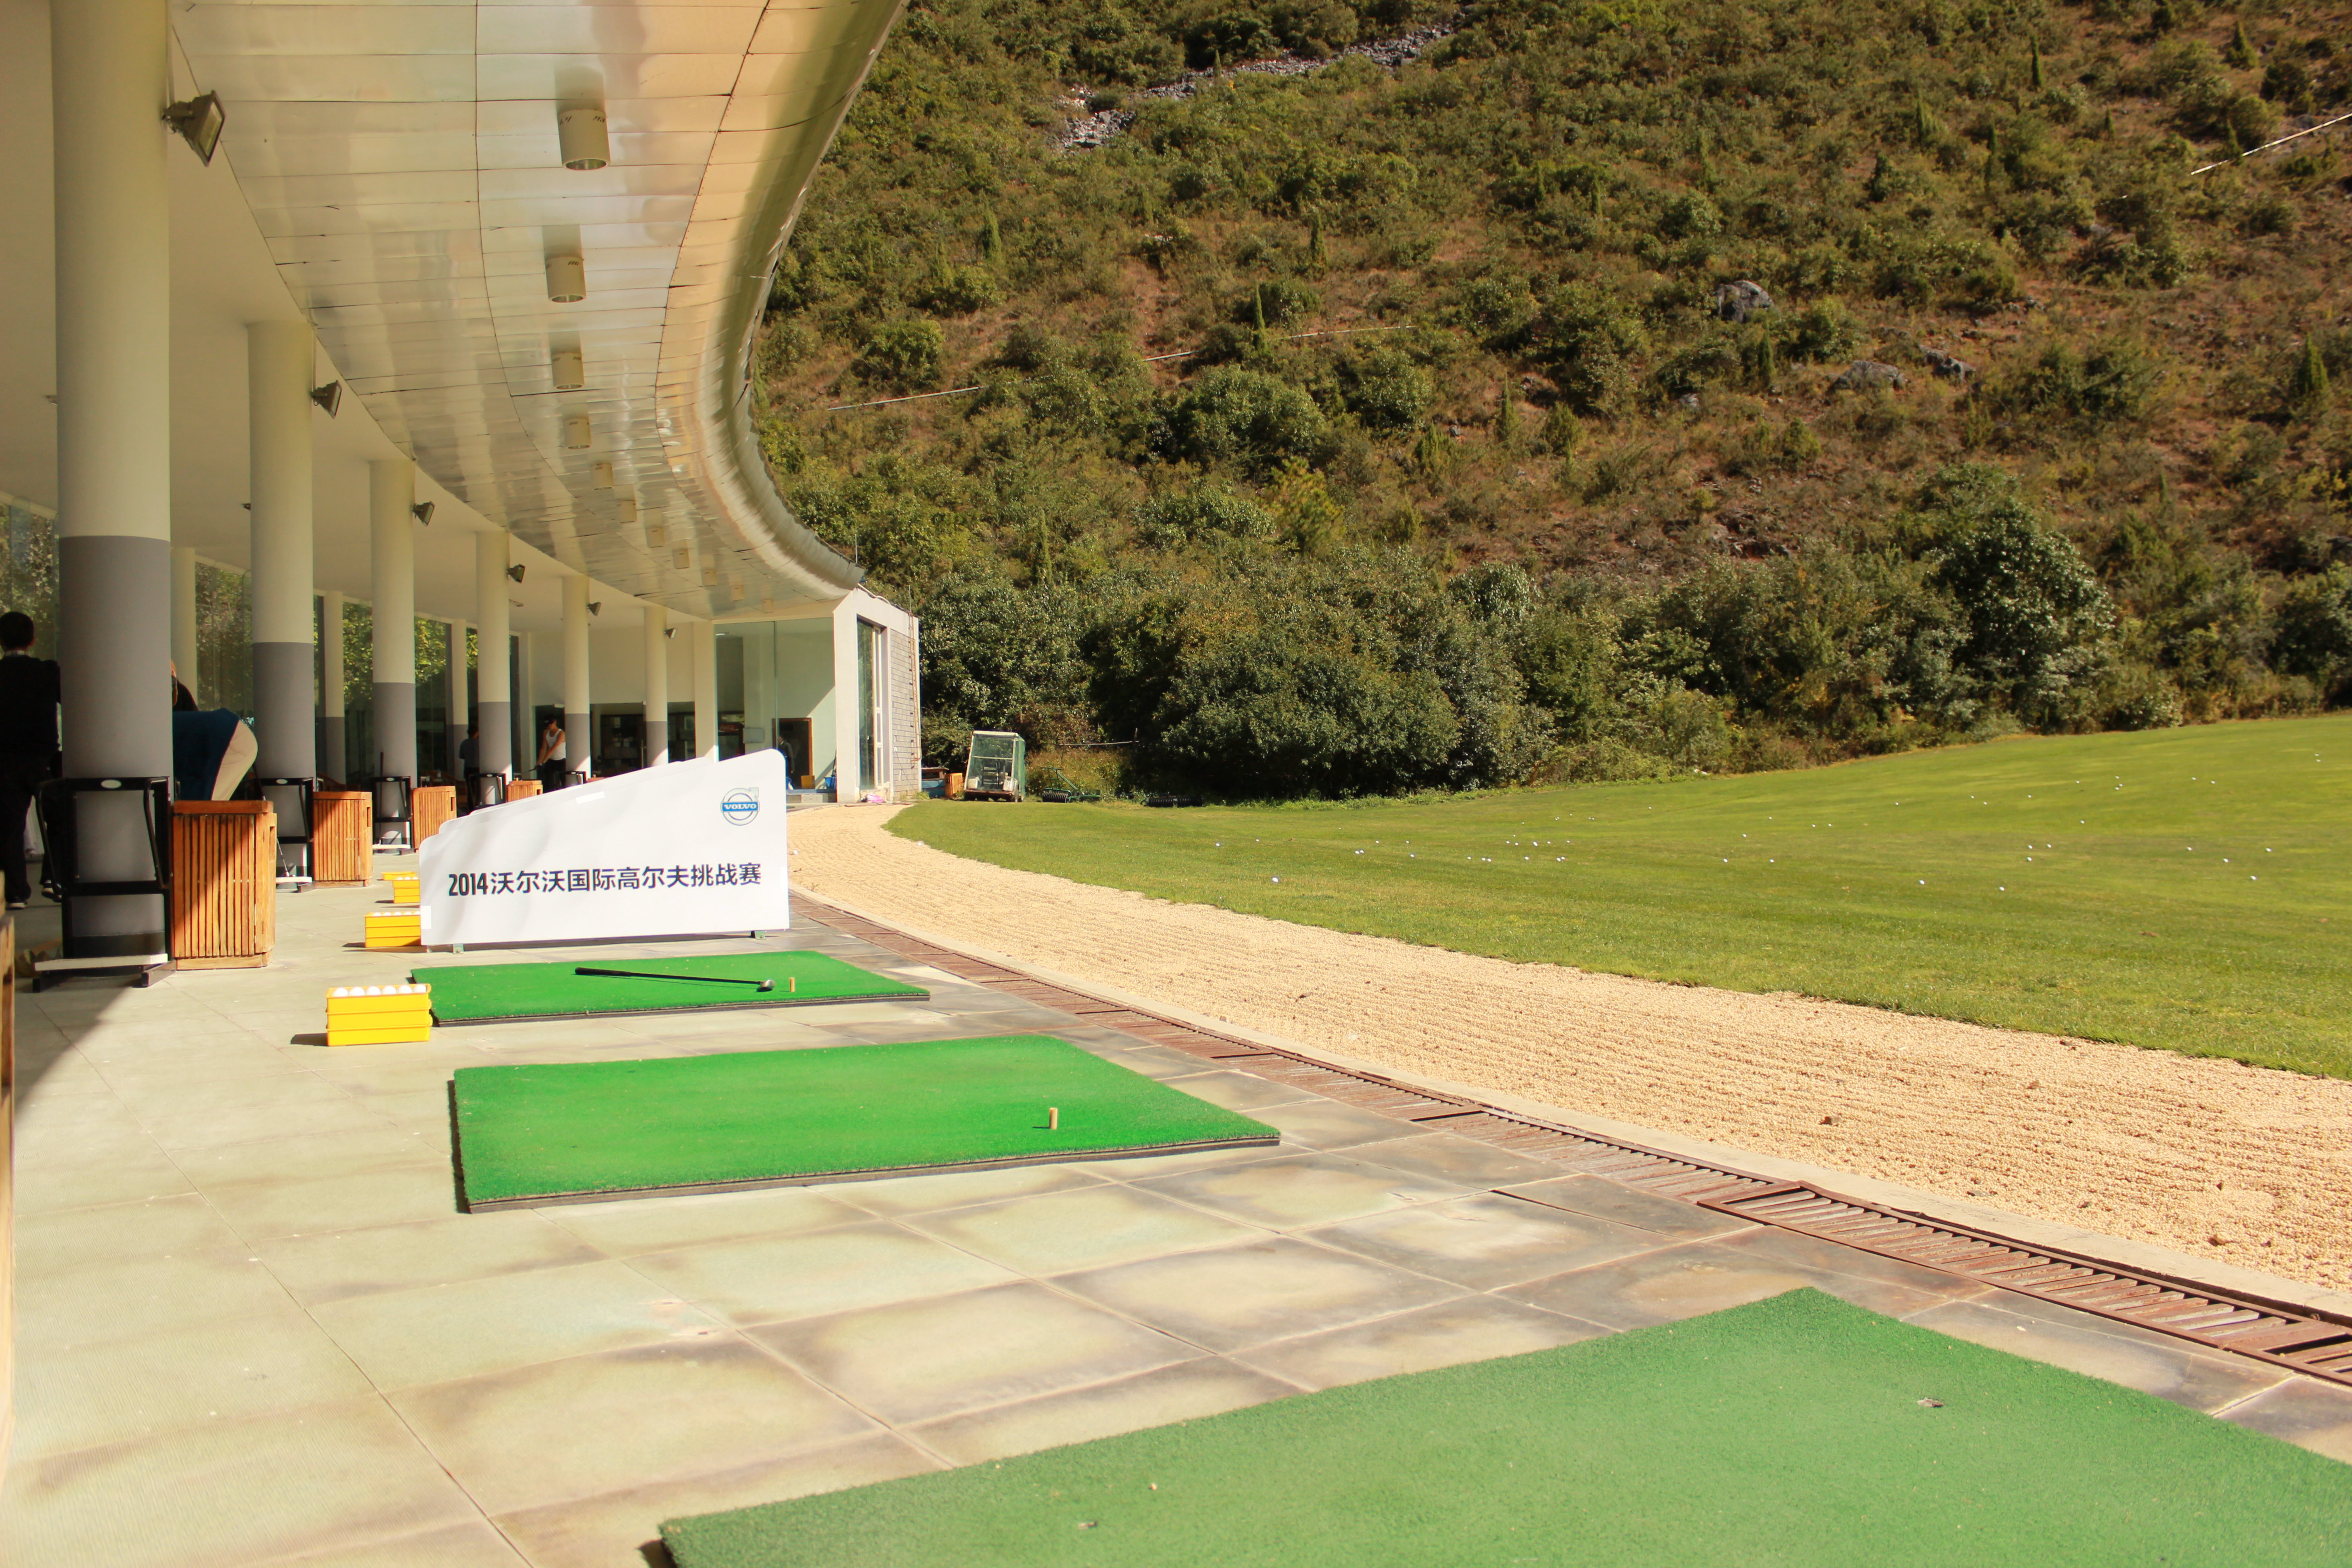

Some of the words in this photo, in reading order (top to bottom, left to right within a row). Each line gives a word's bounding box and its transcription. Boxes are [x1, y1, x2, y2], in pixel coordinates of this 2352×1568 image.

[448, 862, 761, 897] 2014沃尔沃国际高尔夫挑战赛
